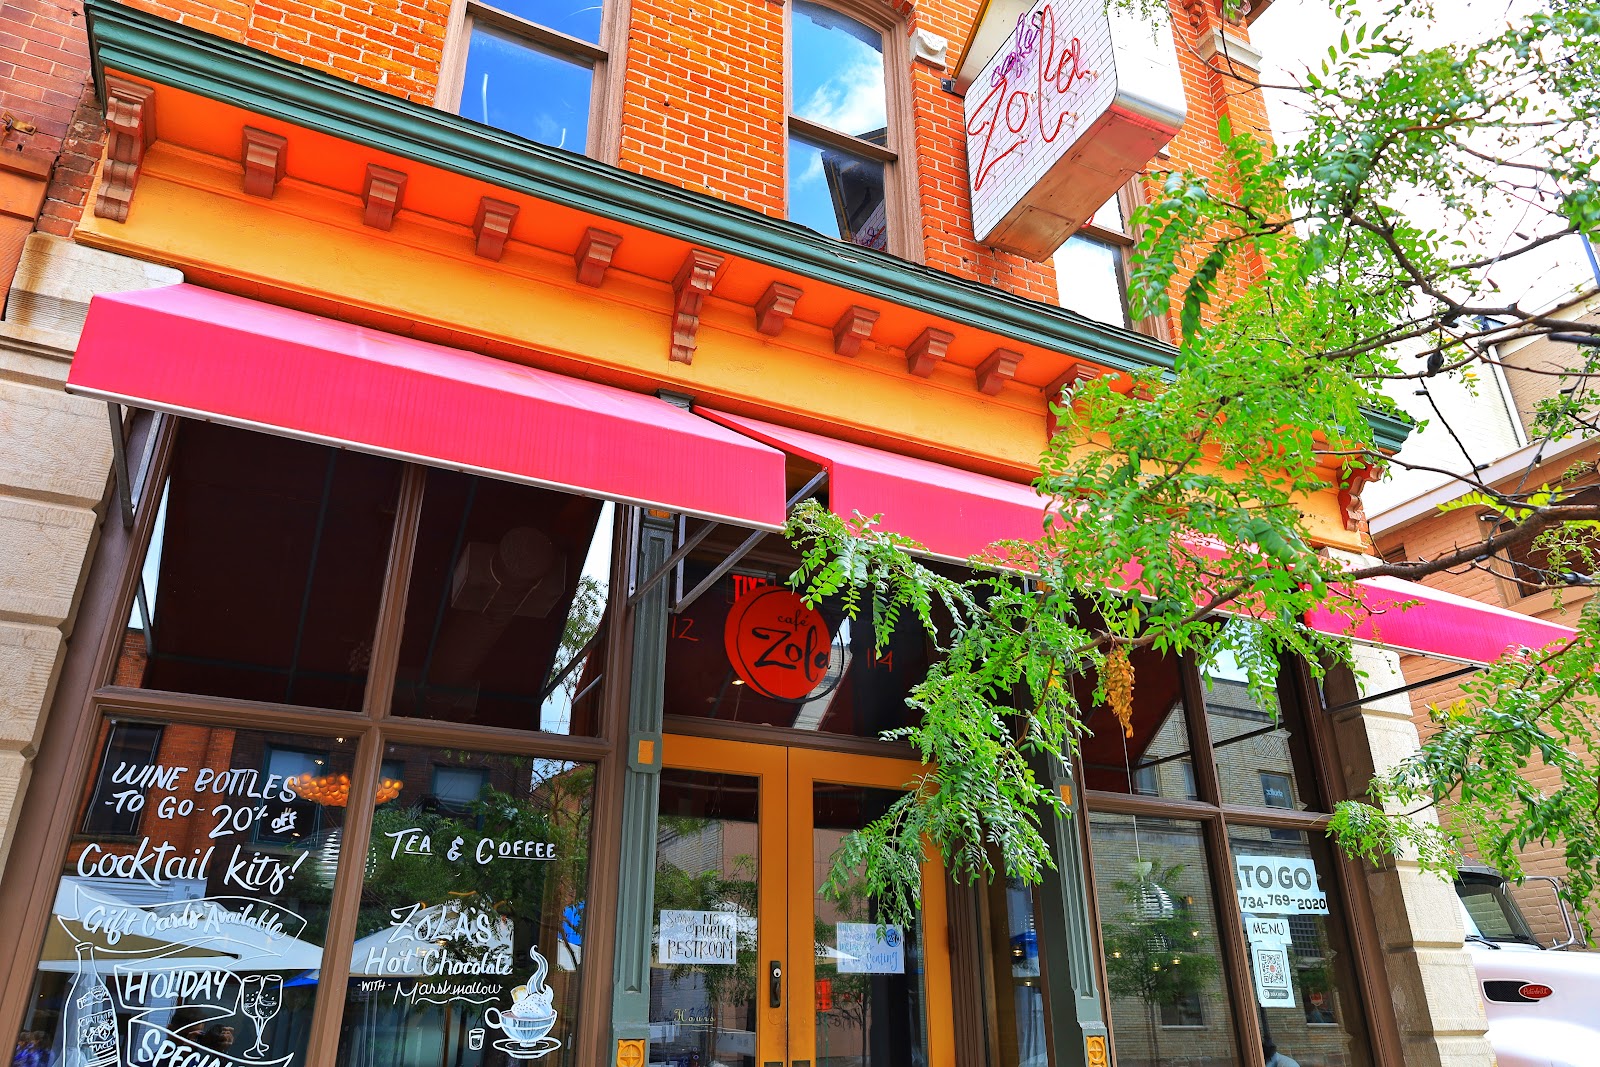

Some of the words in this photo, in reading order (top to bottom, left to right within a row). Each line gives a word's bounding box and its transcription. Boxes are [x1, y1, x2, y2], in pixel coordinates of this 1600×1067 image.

[967, 4, 1098, 191] Zola
[777, 609, 810, 632] café
[751, 625, 832, 683] Zola
[867, 647, 893, 672] 114
[112, 762, 188, 791] WINE
[194, 768, 299, 803] BOTTLES
[208, 804, 269, 839] 20%
[384, 827, 433, 860] TEA
[446, 835, 464, 862] &
[475, 838, 557, 865] COFFEE
[77, 836, 216, 888] Cocktail
[1239, 865, 1274, 889] TO
[1277, 866, 1312, 890] GO
[1240, 894, 1327, 910] 734-769-2020
[82, 906, 142, 945] Gift
[142, 902, 203, 936] Cards
[203, 902, 288, 940] Available
[703, 913, 719, 926] NO
[1252, 922, 1285, 935] MENU
[695, 924, 733, 941] PUBLIC
[364, 946, 415, 976] Hot
[422, 948, 514, 976] Chocolate
[668, 939, 733, 960] RESTROOM
[124, 970, 231, 1004] HOLIDAY
[393, 981, 503, 1005] Marshmallow
[673, 1008, 716, 1023] Hours
